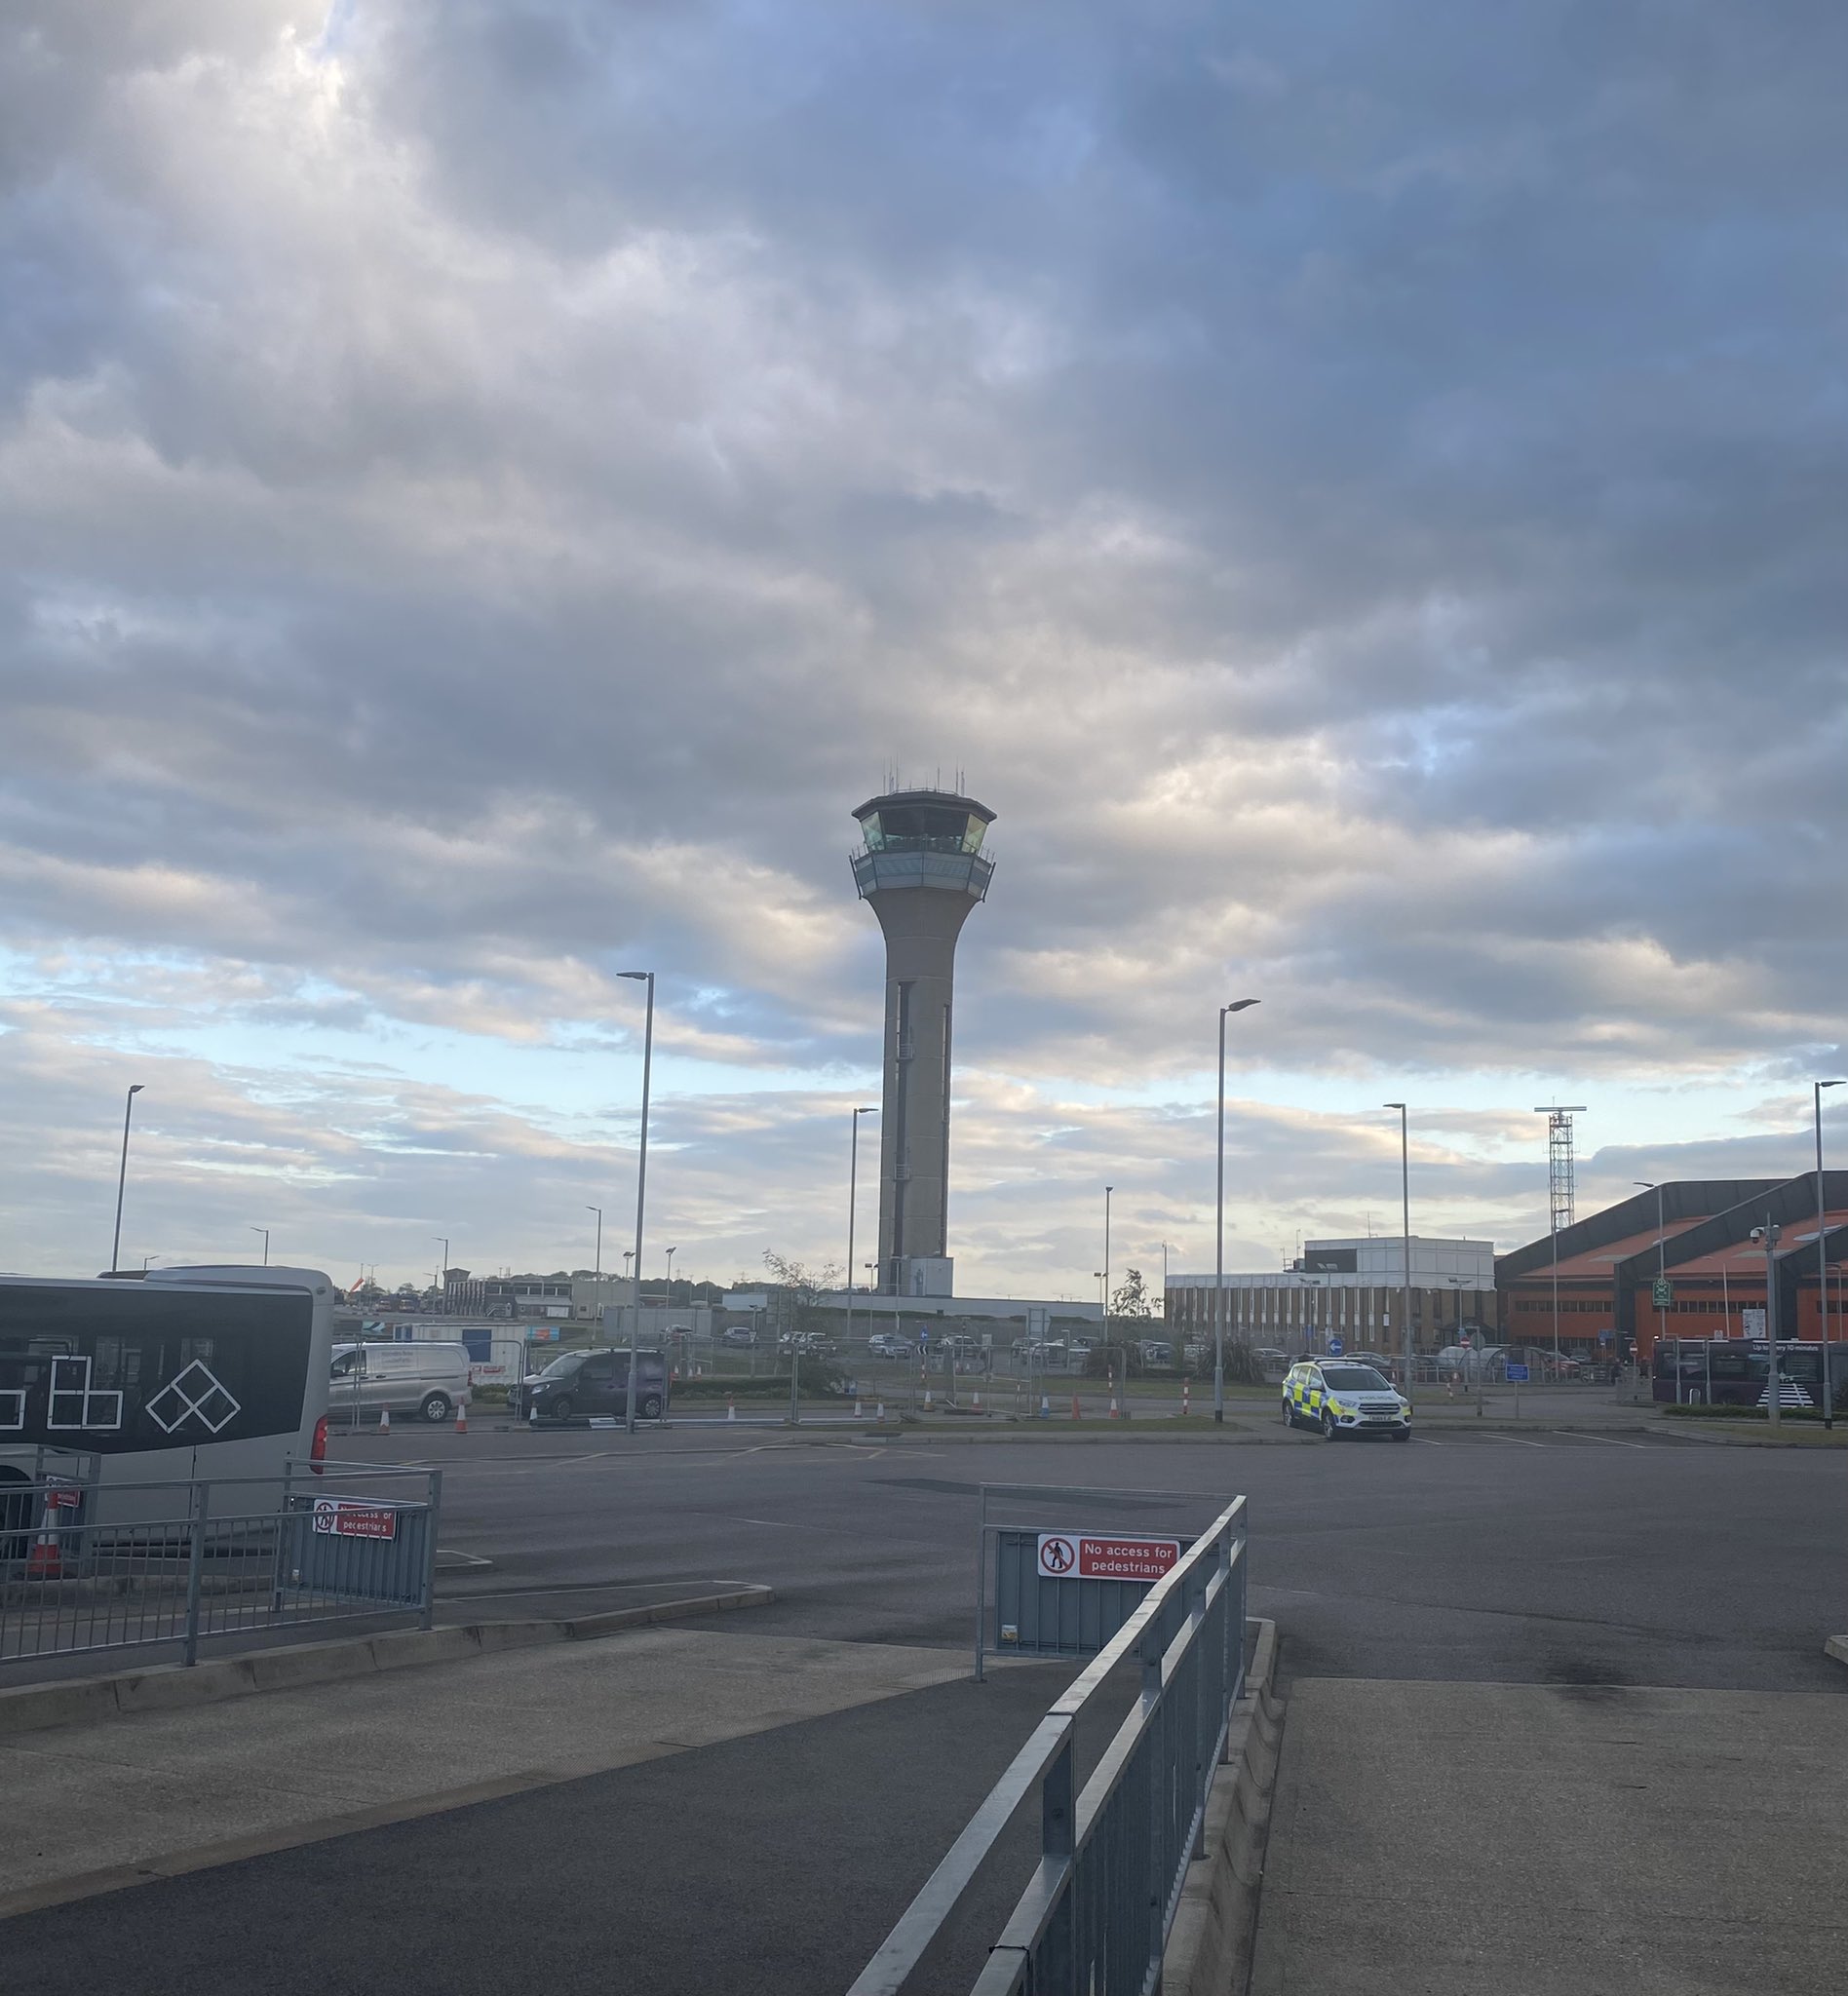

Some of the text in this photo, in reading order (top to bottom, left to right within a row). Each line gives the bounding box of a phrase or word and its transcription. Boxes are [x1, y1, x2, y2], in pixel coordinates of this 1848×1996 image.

[1085, 1543, 1173, 1558] No access for
[1092, 1560, 1166, 1574] pedestrians
